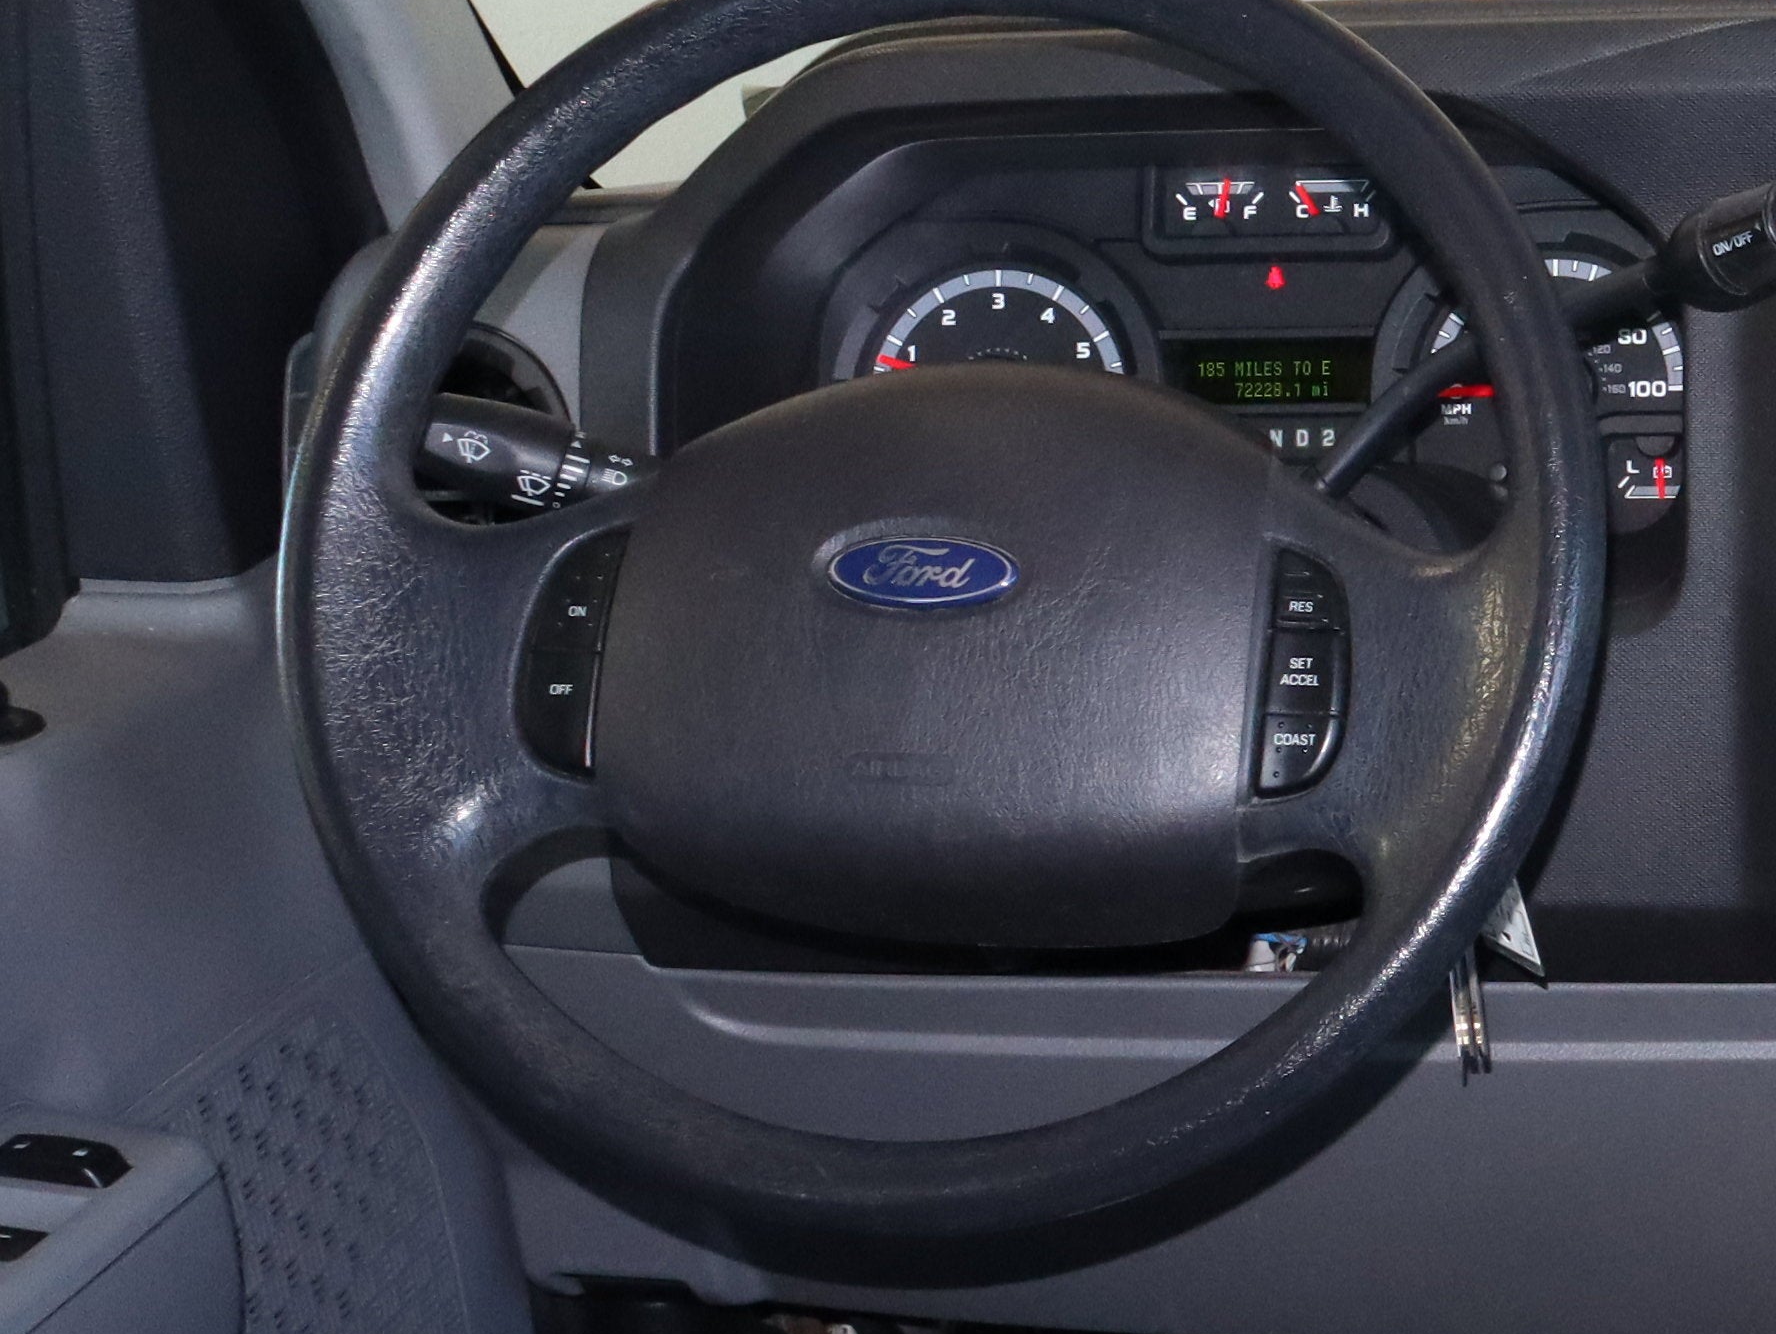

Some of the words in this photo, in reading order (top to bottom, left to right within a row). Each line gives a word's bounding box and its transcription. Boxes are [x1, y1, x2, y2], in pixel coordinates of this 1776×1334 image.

[1183, 206, 1197, 221] E
[1243, 205, 1257, 220] F
[1296, 204, 1310, 218] C
[1353, 203, 1369, 218] H
[1712, 230, 1753, 256] ON/OFF
[991, 292, 1006, 310] 3
[941, 309, 957, 327] 2
[1040, 307, 1056, 324] 4
[906, 344, 917, 362] 1
[1075, 341, 1092, 359] 5
[1235, 360, 1282, 377] MILES
[1294, 360, 1312, 376] TO
[1322, 360, 1331, 375] E
[1311, 381, 1329, 397] mi
[1627, 380, 1668, 398] 100
[1441, 403, 1472, 415] MPH
[1296, 429, 1310, 447] D
[1322, 429, 1336, 447] 2
[1625, 459, 1640, 474] L
[863, 542, 977, 591] Ford
[567, 605, 588, 618] ON
[1288, 600, 1314, 614] RES
[1289, 657, 1314, 670] SET
[1279, 674, 1320, 687] ACCEL
[549, 683, 574, 696] OFF
[1273, 733, 1317, 747] COAST
